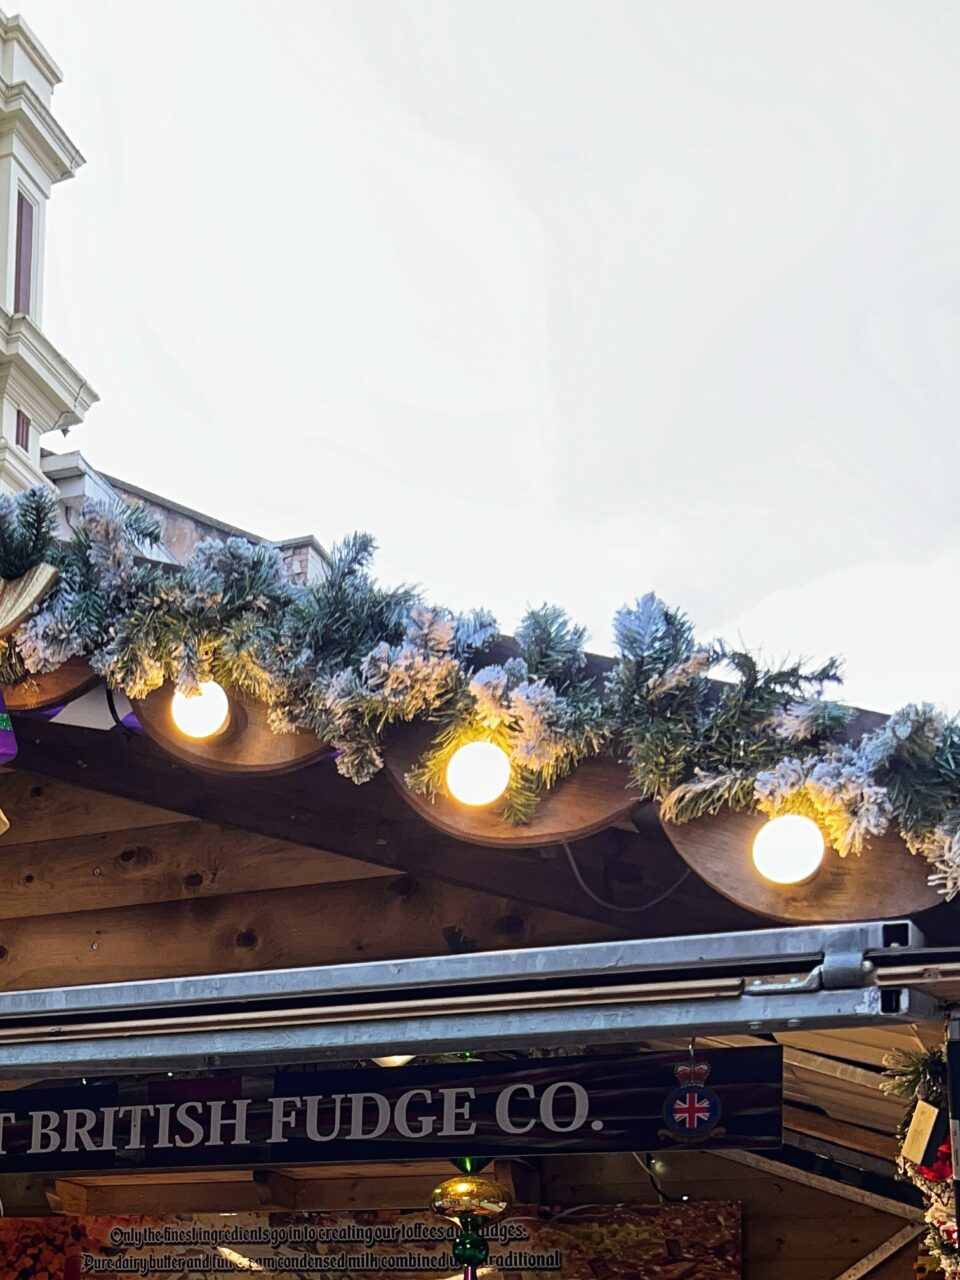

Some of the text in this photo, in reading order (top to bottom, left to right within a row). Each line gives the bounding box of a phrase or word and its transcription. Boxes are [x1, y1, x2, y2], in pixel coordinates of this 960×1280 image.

[27, 1099, 252, 1154] BRITISH
[266, 1087, 477, 1143] FUDGE
[496, 1082, 604, 1134] CO.
[110, 1227, 141, 1247] Only
[143, 1227, 163, 1243] the
[164, 1226, 197, 1243] finest
[198, 1226, 270, 1246] ingredients
[271, 1227, 286, 1247] go
[289, 1225, 301, 1241] in
[303, 1225, 315, 1241] to
[318, 1225, 373, 1245] creating
[374, 1227, 400, 1241] our
[401, 1223, 444, 1240] toffees
[446, 1227, 461, 1240] an
[81, 1252, 115, 1272] Pure
[115, 1252, 148, 1274] dairy
[149, 1253, 186, 1271] butter
[186, 1253, 209, 1270] and
[277, 1253, 345, 1270] condensed
[348, 1252, 379, 1269] milk
[381, 1251, 448, 1269] combined
